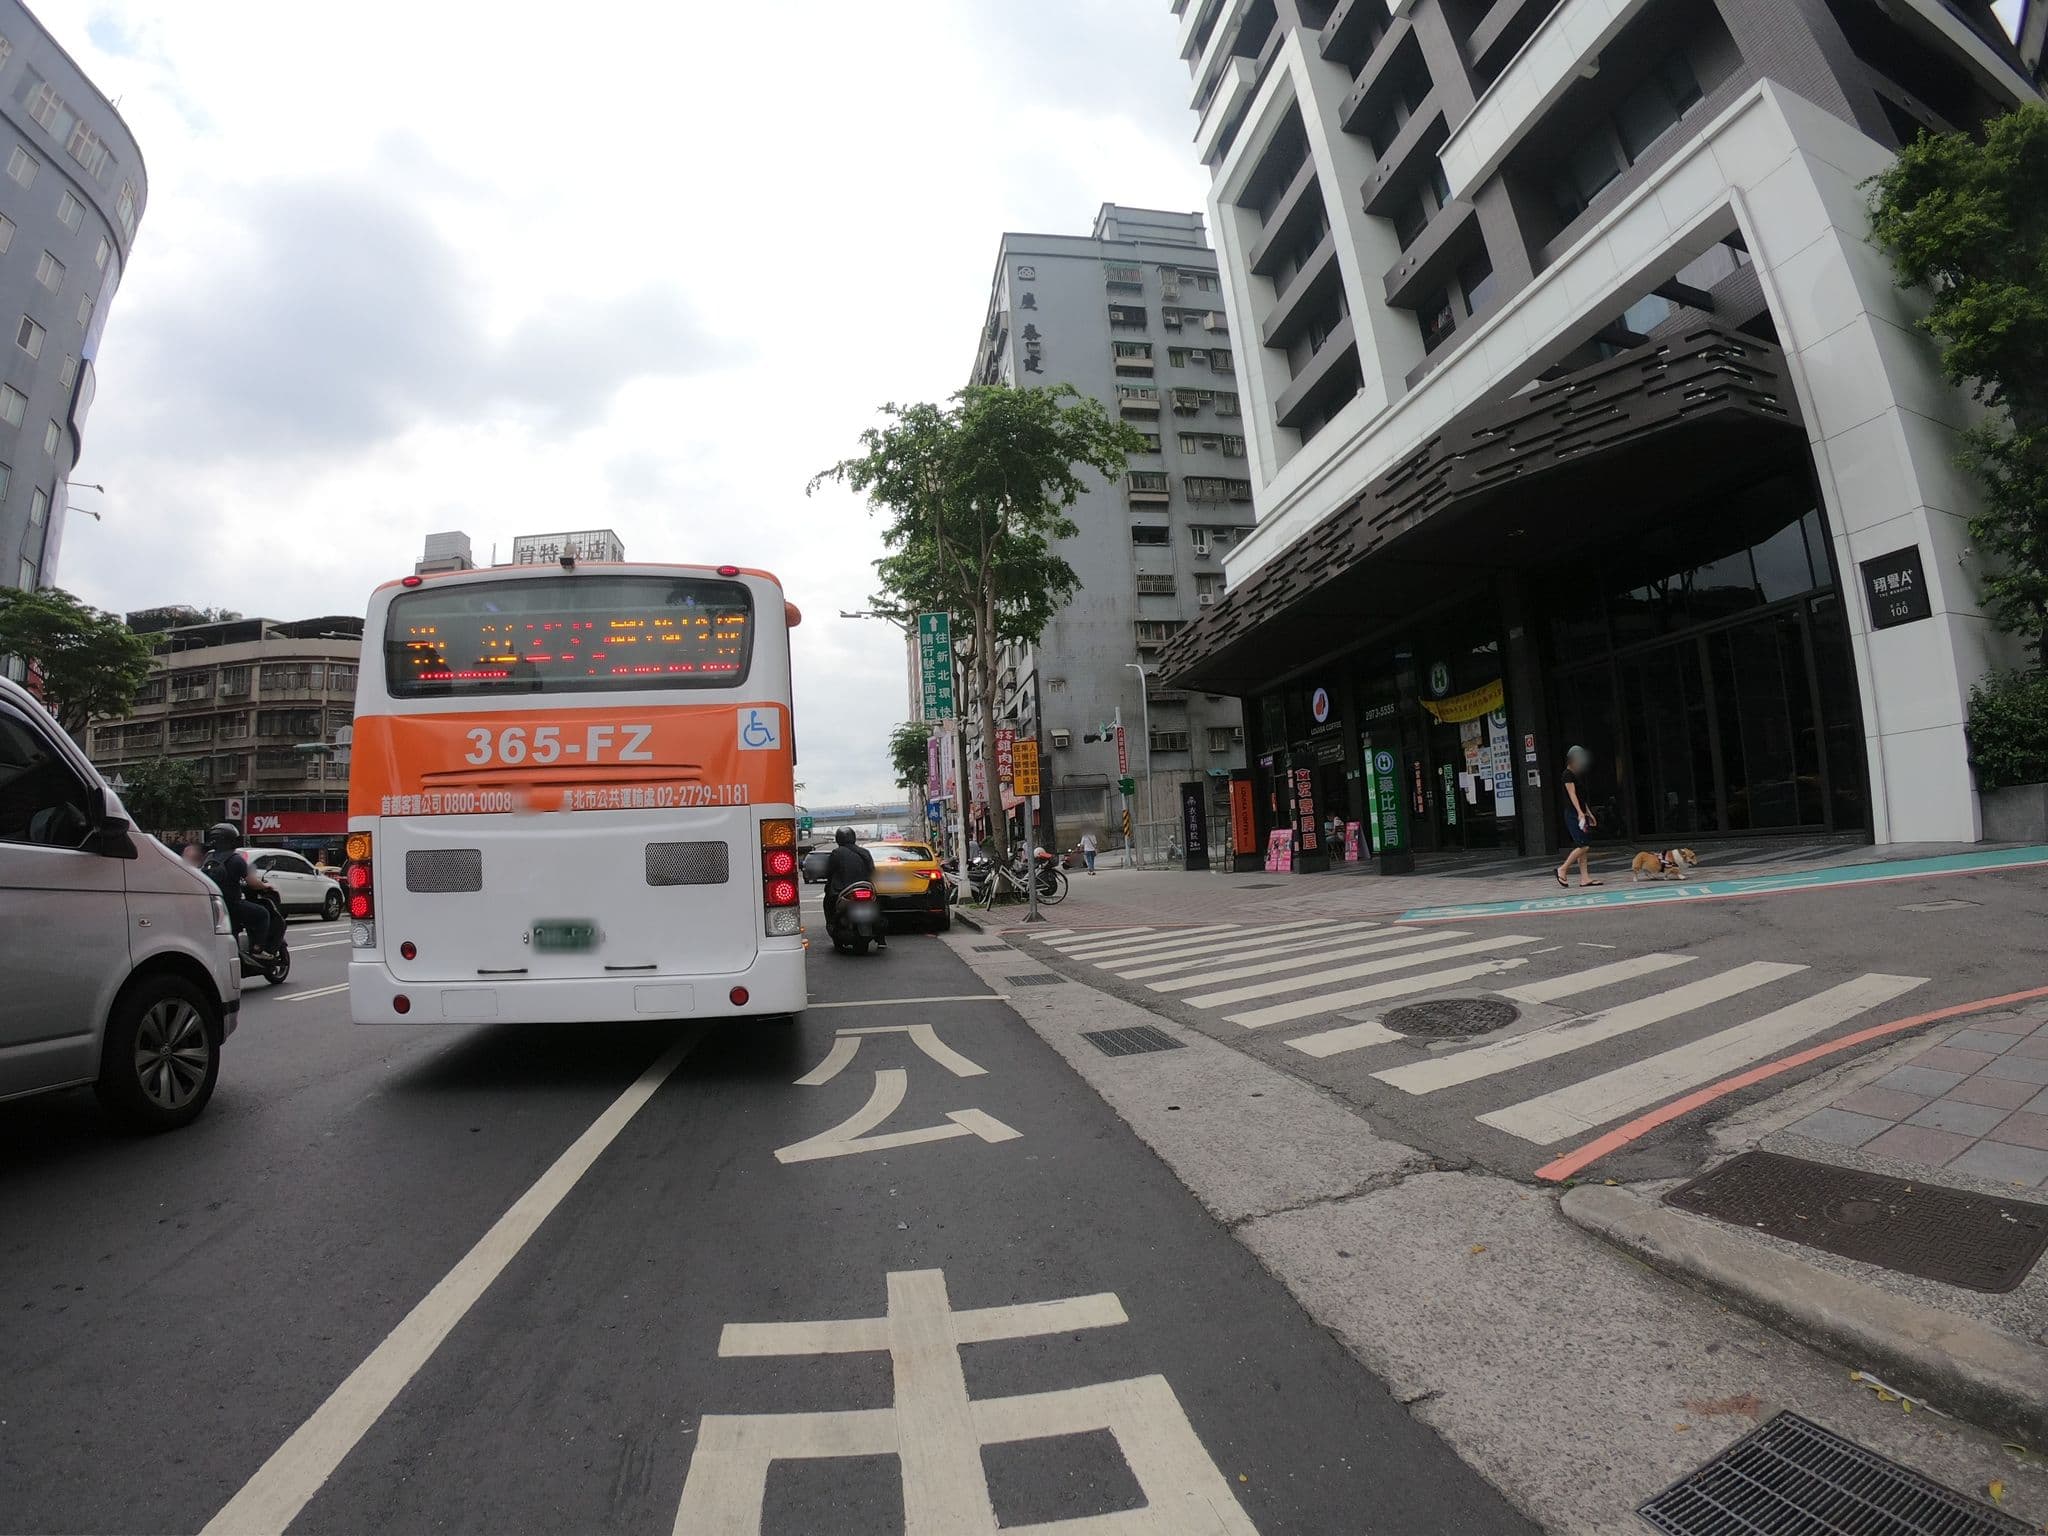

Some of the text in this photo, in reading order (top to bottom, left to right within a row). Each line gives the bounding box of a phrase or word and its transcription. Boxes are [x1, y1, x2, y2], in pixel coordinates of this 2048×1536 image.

[1890, 605, 1909, 617] 100
[921, 633, 938, 719] 請行駛平面車道
[935, 632, 952, 719] 往新北環快
[1326, 720, 1342, 731] COFFEE
[465, 724, 653, 765] 365-FZ
[381, 791, 530, 815] 首都客運公司 0800-0008
[657, 783, 749, 808] 02-2729-1181
[252, 816, 281, 832] SYM
